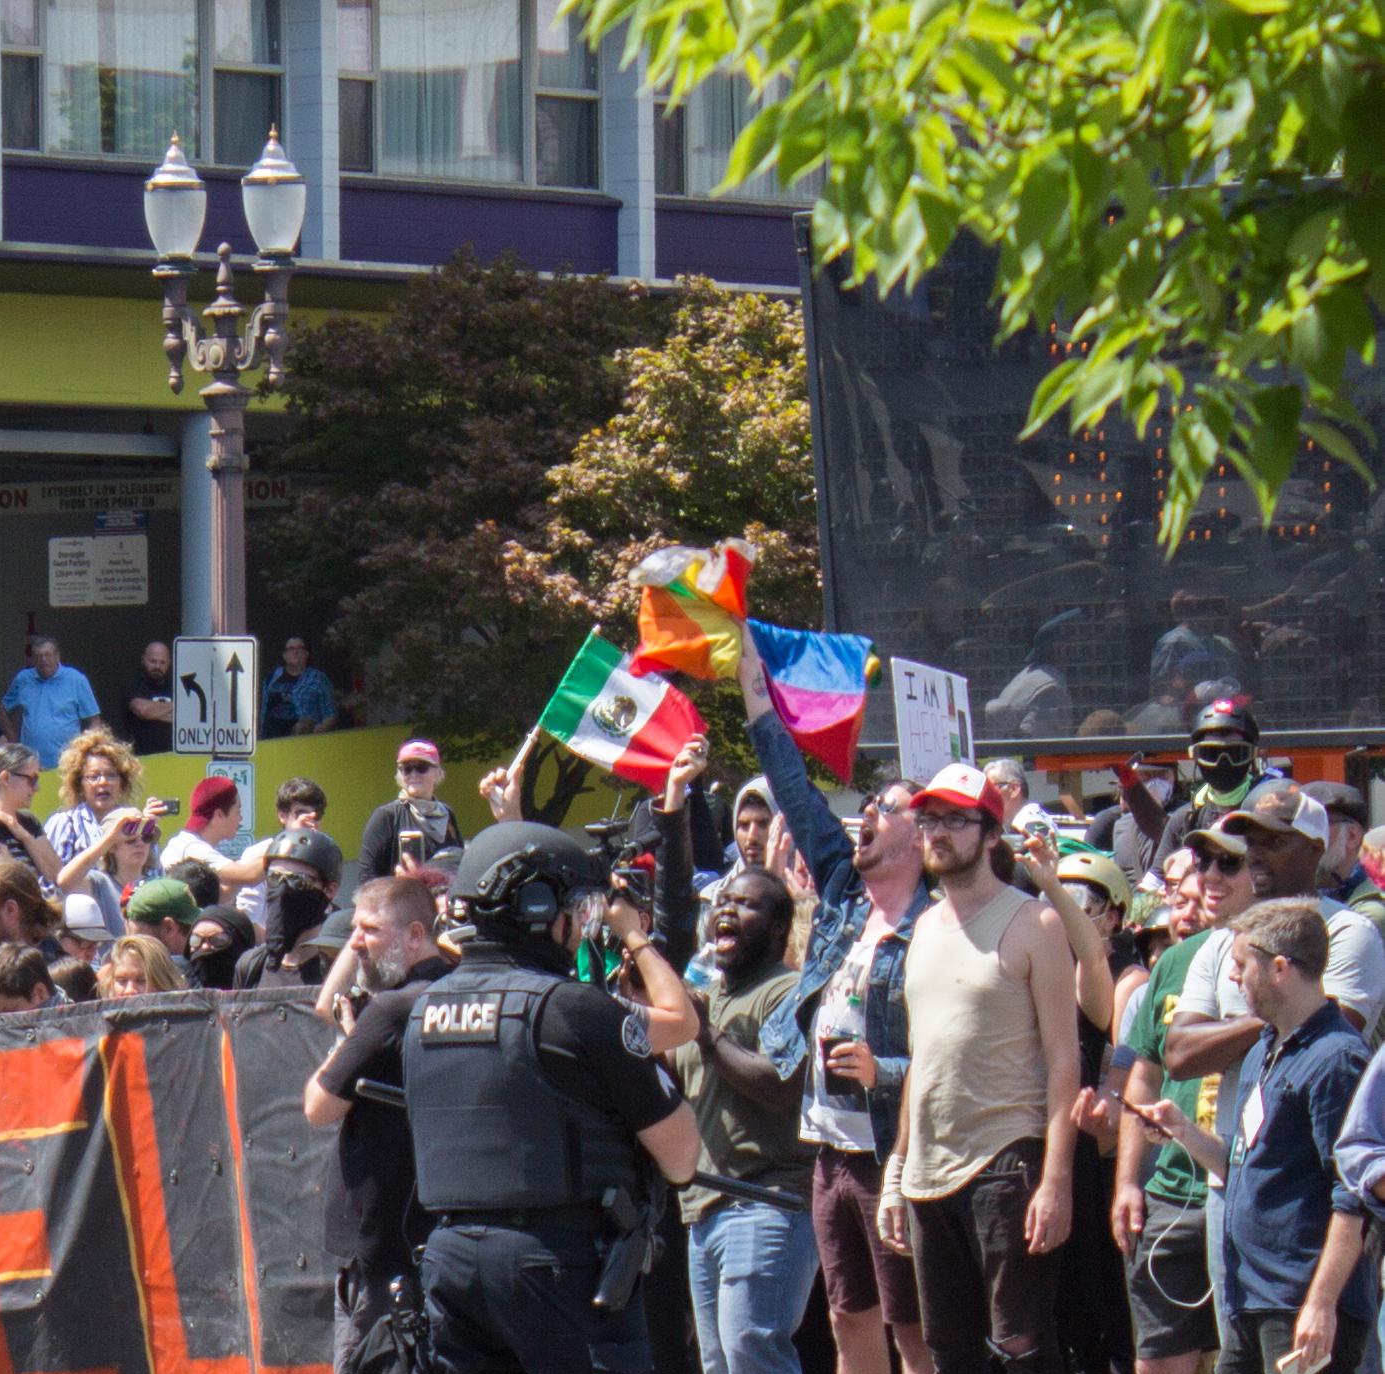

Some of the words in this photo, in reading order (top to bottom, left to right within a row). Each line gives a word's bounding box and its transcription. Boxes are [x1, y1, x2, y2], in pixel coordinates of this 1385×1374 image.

[41, 484, 94, 498] EXTREMELY
[96, 484, 118, 497] LOW
[119, 482, 173, 496] CLEARANCE
[58, 498, 86, 510] FROM
[89, 497, 110, 510] THIS
[111, 496, 140, 509] POINT
[141, 496, 156, 508] ON
[904, 670, 918, 701] I
[923, 676, 940, 710] AM
[178, 727, 212, 746] ONLY
[216, 727, 251, 746] ONLY
[908, 708, 951, 756] HERE
[422, 1002, 499, 1034] POLICE
